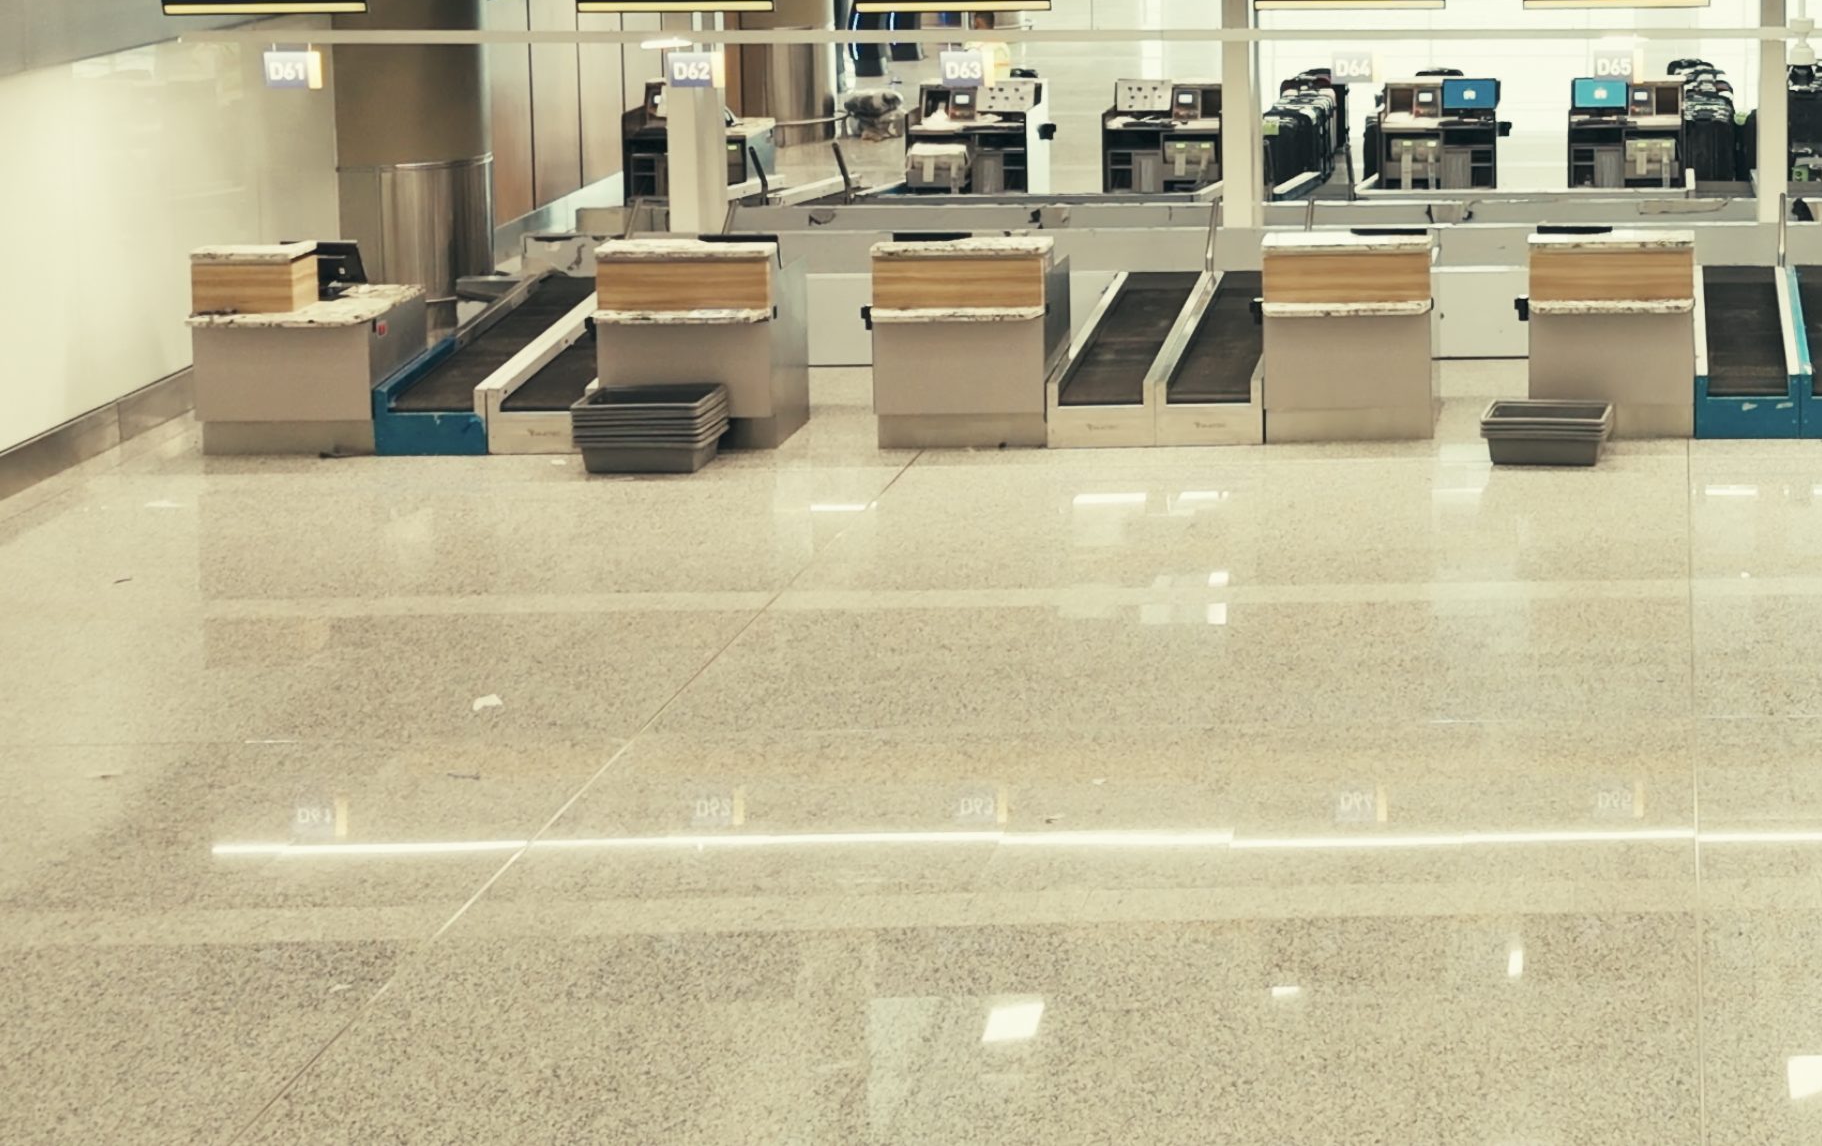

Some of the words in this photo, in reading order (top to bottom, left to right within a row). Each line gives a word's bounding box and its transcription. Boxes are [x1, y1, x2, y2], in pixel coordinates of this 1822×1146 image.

[269, 61, 305, 81] D61
[673, 61, 710, 81] D62
[945, 61, 982, 80] D63
[1335, 59, 1371, 78] D64
[1597, 58, 1632, 76] D65
